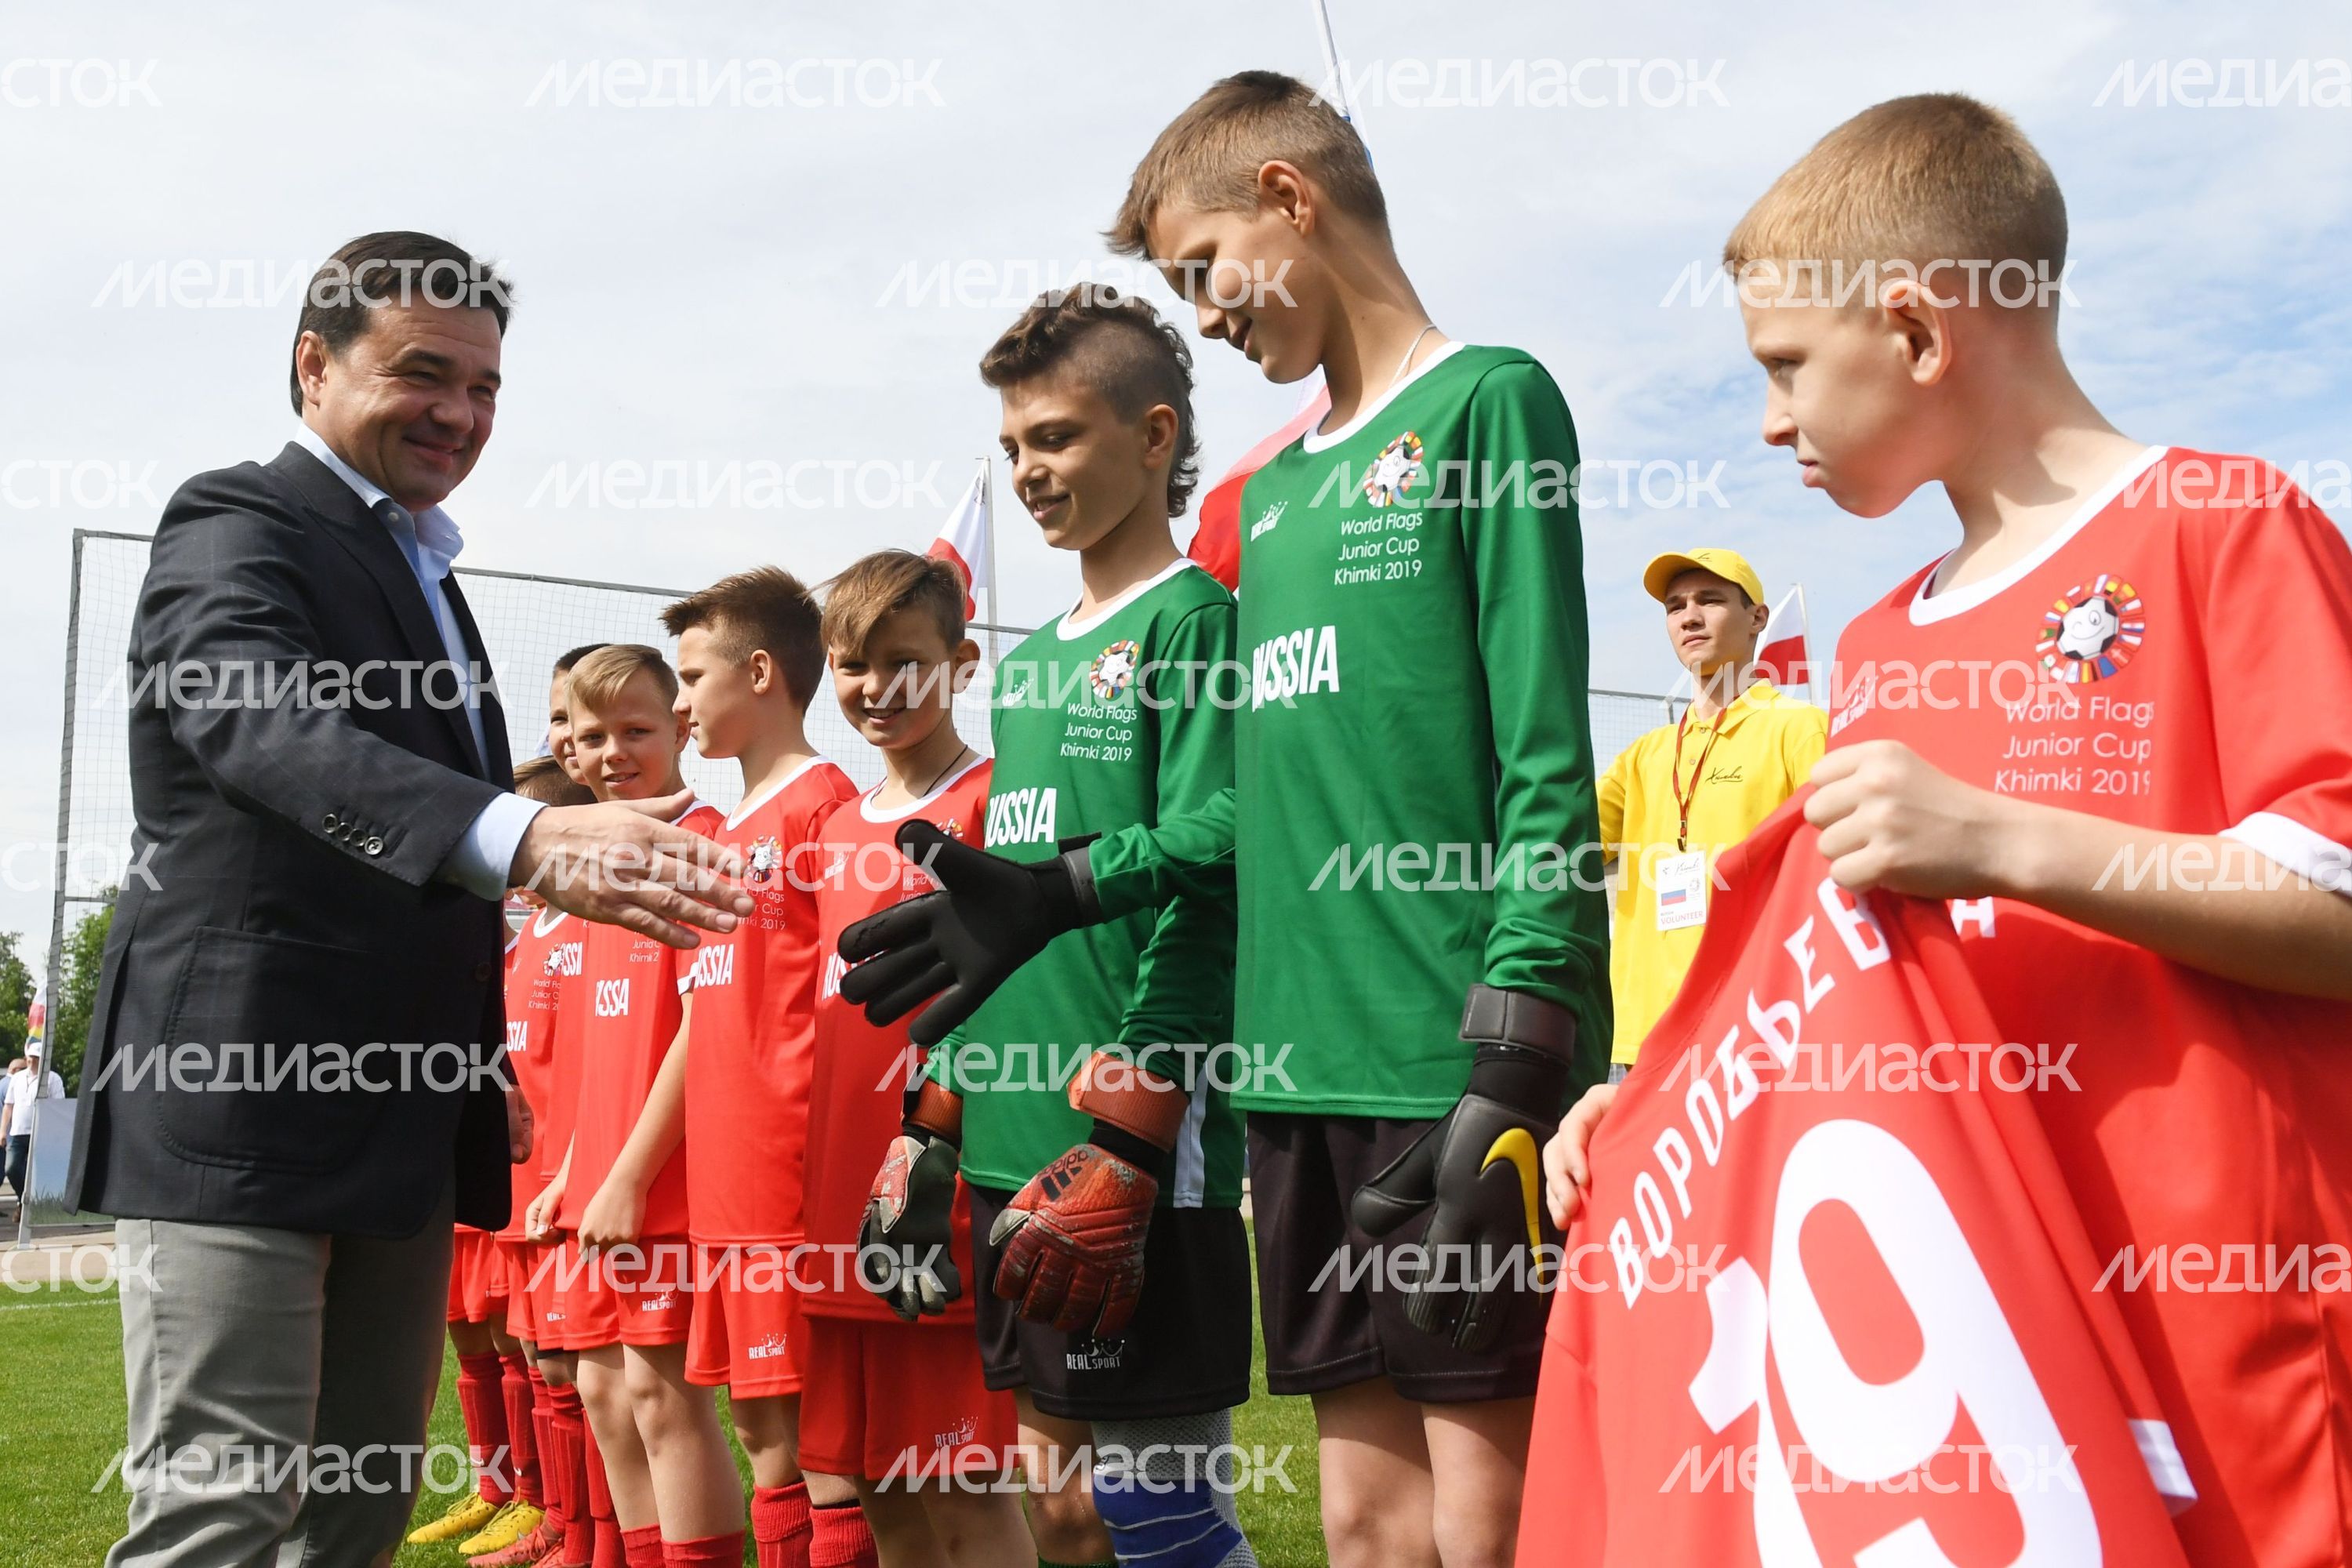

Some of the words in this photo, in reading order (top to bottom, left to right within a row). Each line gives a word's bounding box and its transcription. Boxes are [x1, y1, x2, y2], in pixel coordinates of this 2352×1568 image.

[1341, 515, 1382, 535] World
[1385, 512, 1423, 532] Flags
[1338, 540, 1382, 561] Junior
[1385, 537, 1420, 557] Cup
[1334, 563, 1381, 586] Khimki
[1385, 559, 1422, 580] 2019
[1067, 702, 1104, 720] World
[1106, 706, 1138, 724] Flags
[2005, 696, 2081, 723] World
[1065, 723, 1104, 739] Junior
[1105, 726, 1132, 743] Cup
[1060, 742, 1099, 760] Khimki
[1102, 746, 1132, 761] 2019
[2002, 731, 2085, 759] Junior
[2092, 732, 2151, 764] Cup
[1994, 767, 2082, 793] Khimki
[761, 887, 785, 903] Flags
[761, 902, 784, 917] Cup
[760, 917, 786, 931] 2019
[1609, 877, 1892, 1310] ВОРОБЬЕВ
[748, 1345, 768, 1360] REAL
[768, 1345, 786, 1357] SPORT
[1066, 1353, 1091, 1370] REAL
[1091, 1356, 1121, 1370] SPORT
[935, 1432, 960, 1448] REAL
